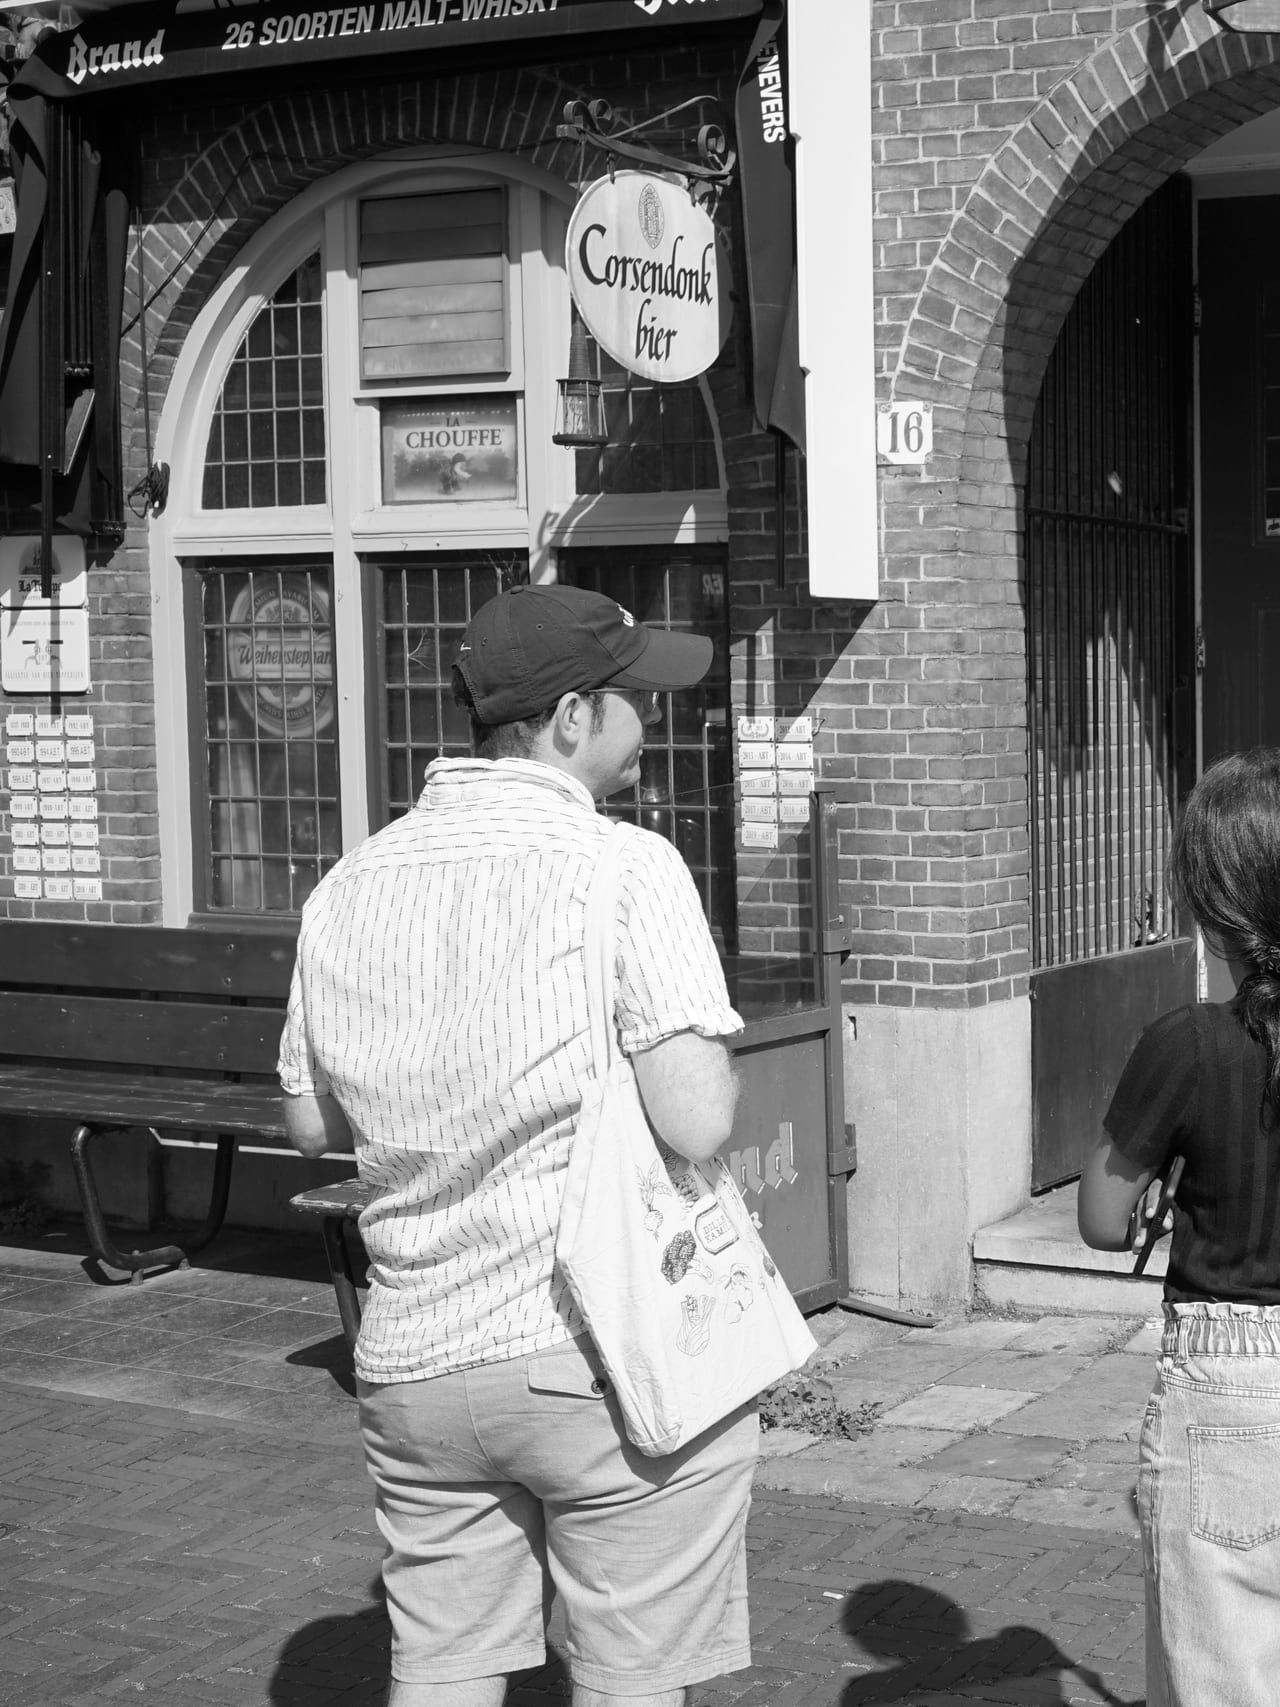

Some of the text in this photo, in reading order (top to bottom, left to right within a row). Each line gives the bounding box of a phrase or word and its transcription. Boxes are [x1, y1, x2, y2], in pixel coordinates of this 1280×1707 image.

[221, 21, 255, 50] 26
[258, 5, 375, 46] SOORTEN
[66, 29, 165, 85] Brand
[757, 40, 787, 143] ENEVERS
[579, 223, 714, 306] Corsendonk
[635, 298, 678, 362] bier
[405, 429, 502, 449] CHOUFFE
[446, 417, 461, 427] LA
[889, 411, 924, 453] 16
